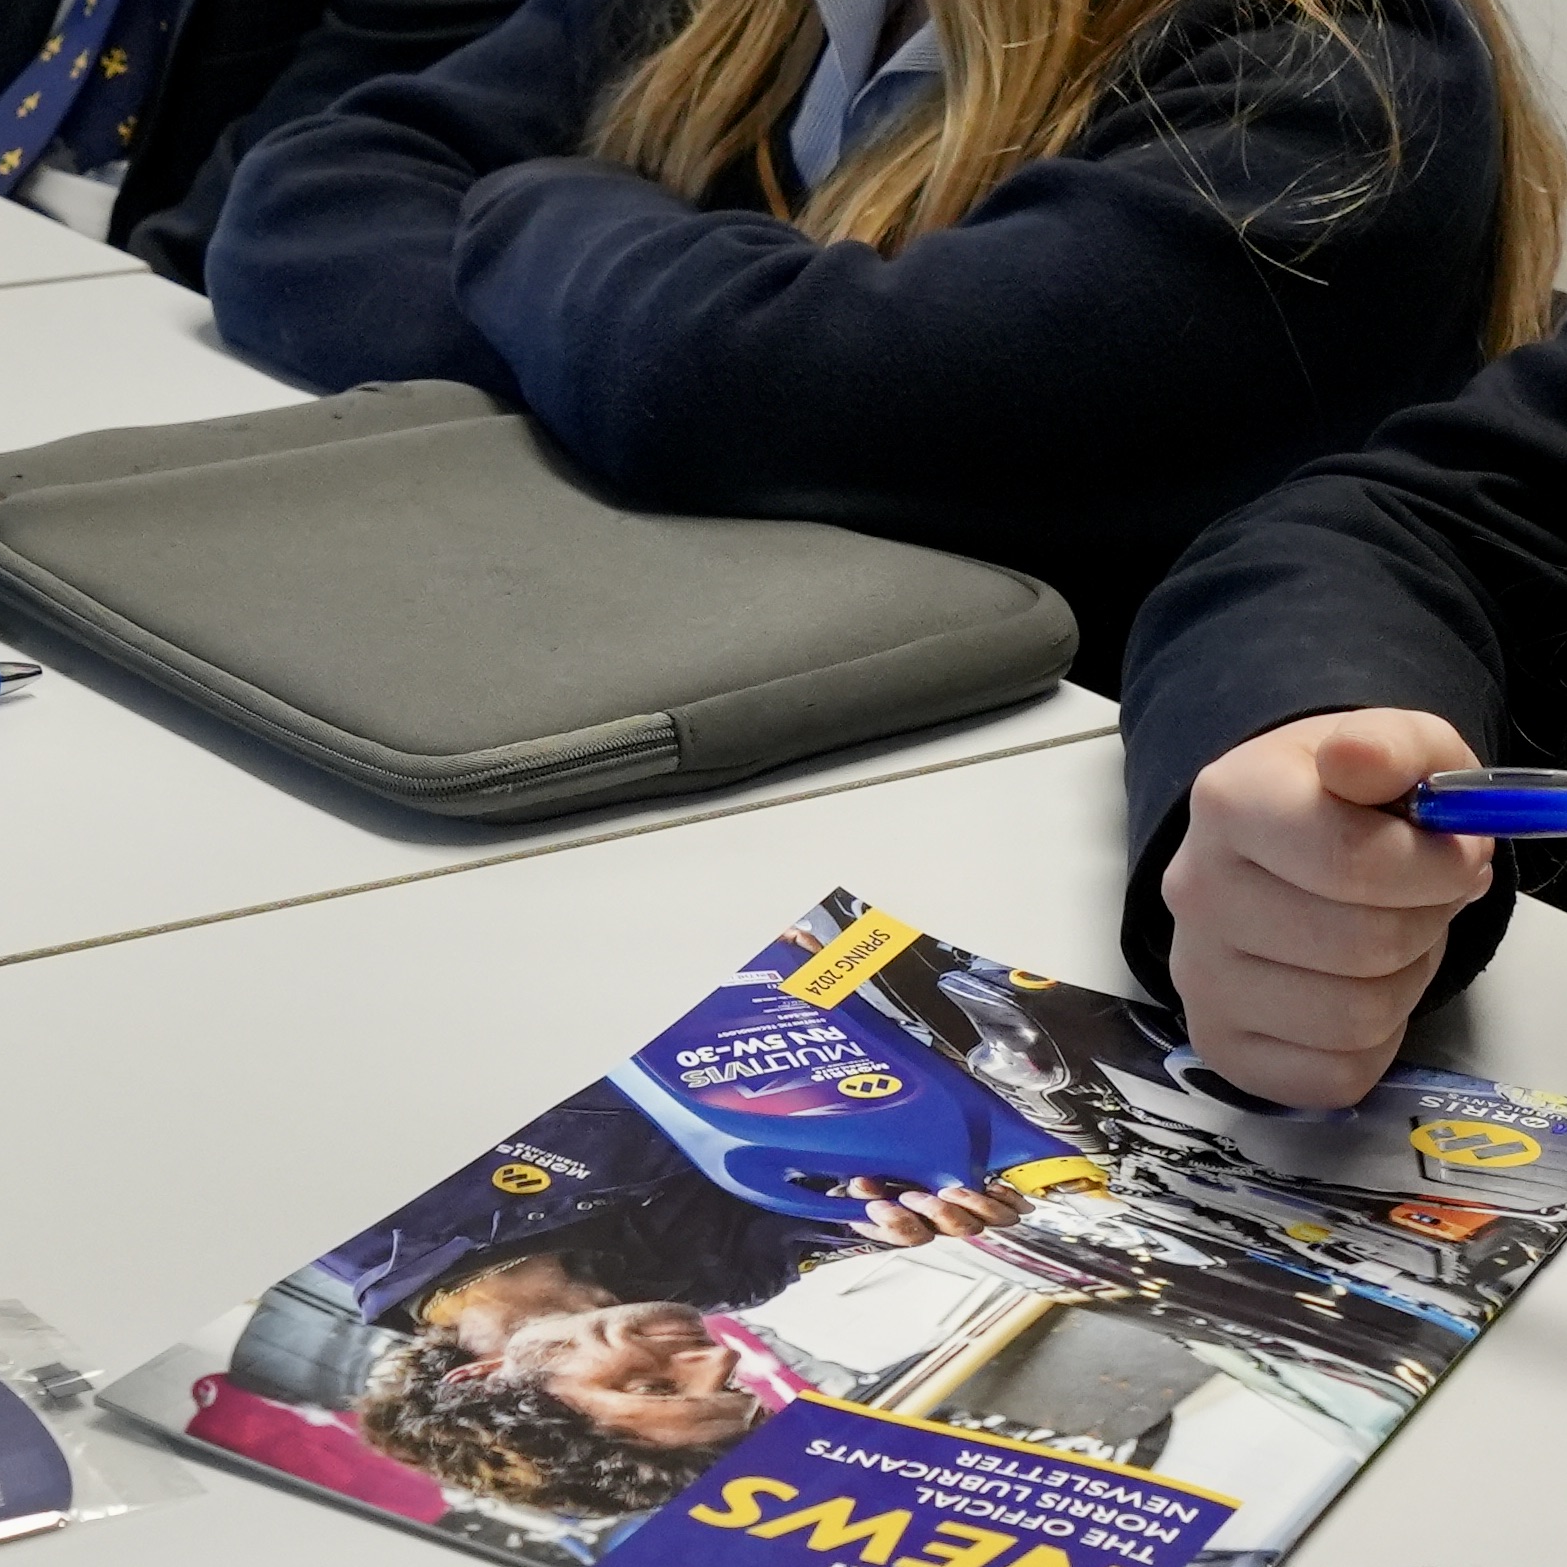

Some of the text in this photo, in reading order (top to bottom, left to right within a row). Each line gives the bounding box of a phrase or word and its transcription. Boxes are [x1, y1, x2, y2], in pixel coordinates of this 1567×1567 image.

[834, 928, 892, 973] SPRING
[804, 968, 844, 996] 2024
[675, 1032, 789, 1068] 5W-30
[786, 1024, 848, 1047] RN
[679, 1040, 870, 1089] MULTIVIS
[494, 1143, 592, 1181] MORRIS
[805, 1438, 1182, 1546] MORRIS LUBRICANTS
[954, 1449, 1201, 1525] NEWSLETTER
[914, 1484, 1160, 1566] THE OFFICIAL
